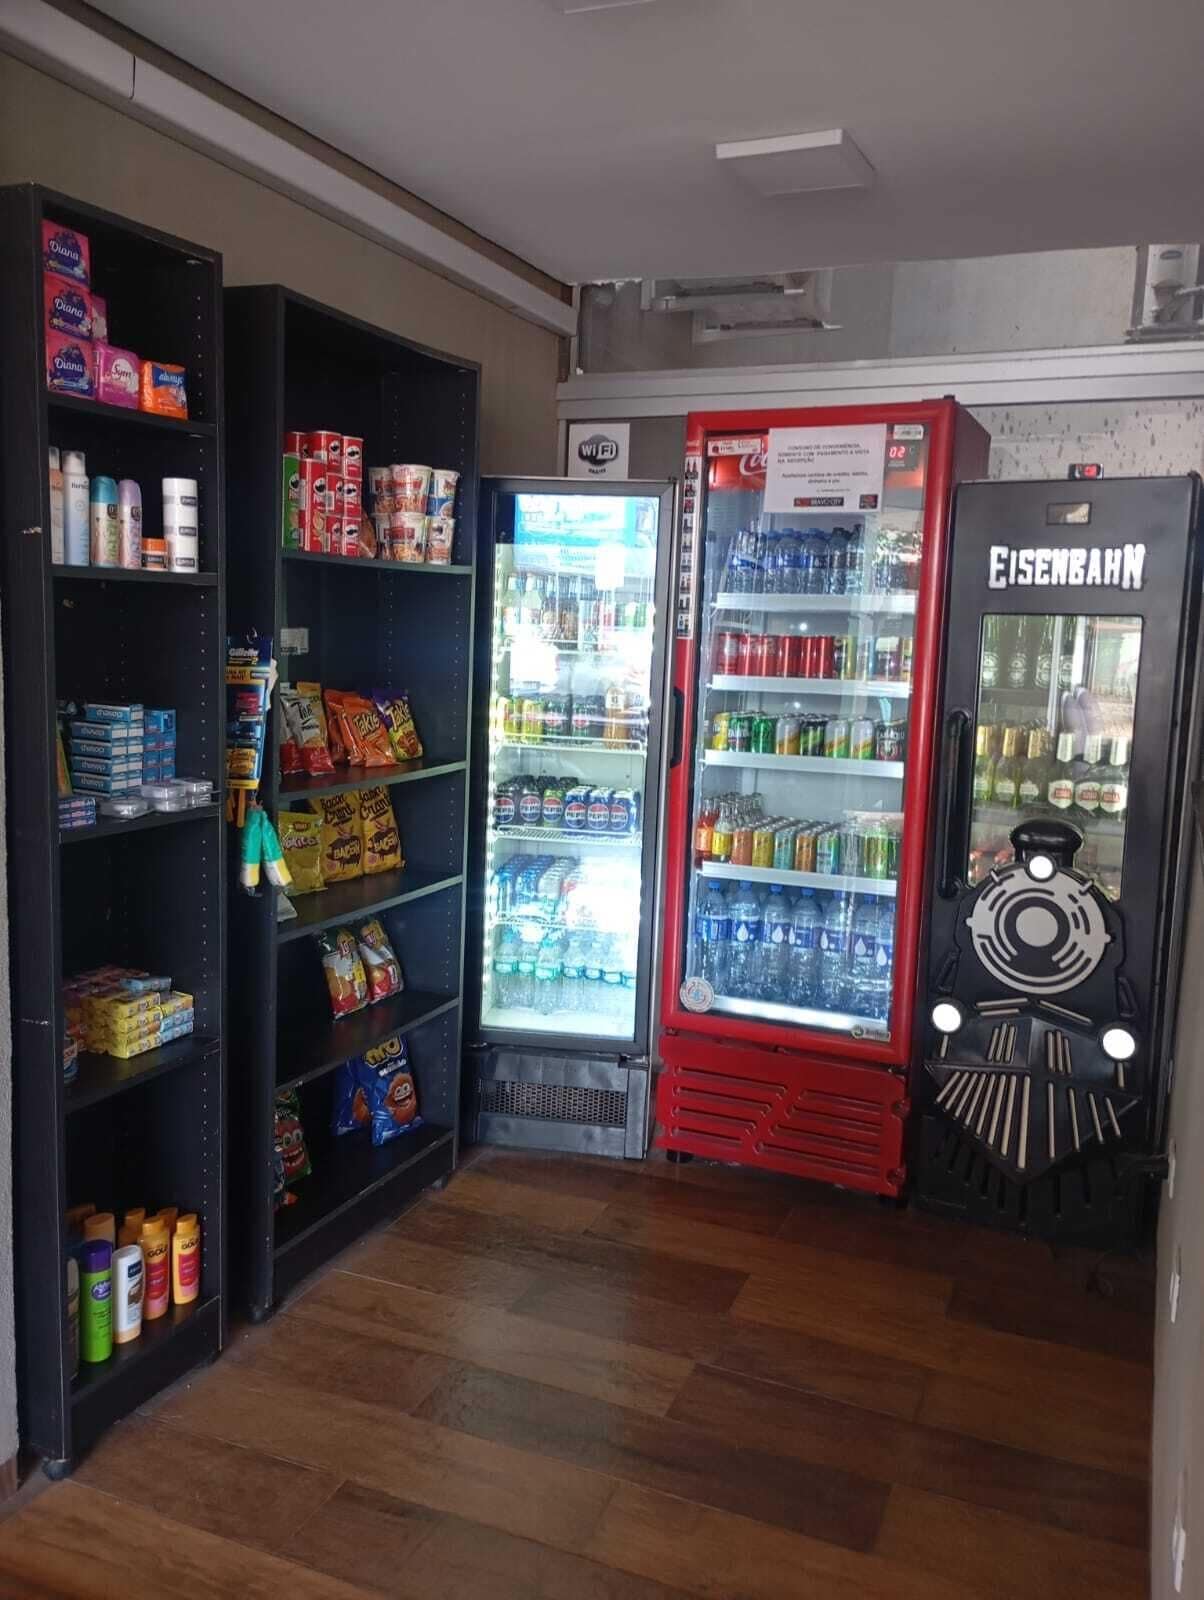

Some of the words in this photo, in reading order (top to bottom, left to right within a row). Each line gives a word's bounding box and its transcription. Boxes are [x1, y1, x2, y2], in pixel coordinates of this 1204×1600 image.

[49, 239, 80, 261] Diana
[54, 298, 84, 318] Diana
[54, 356, 84, 373] Diana
[988, 543, 1147, 590] EISENBAHN
[353, 711, 381, 738] Takis
